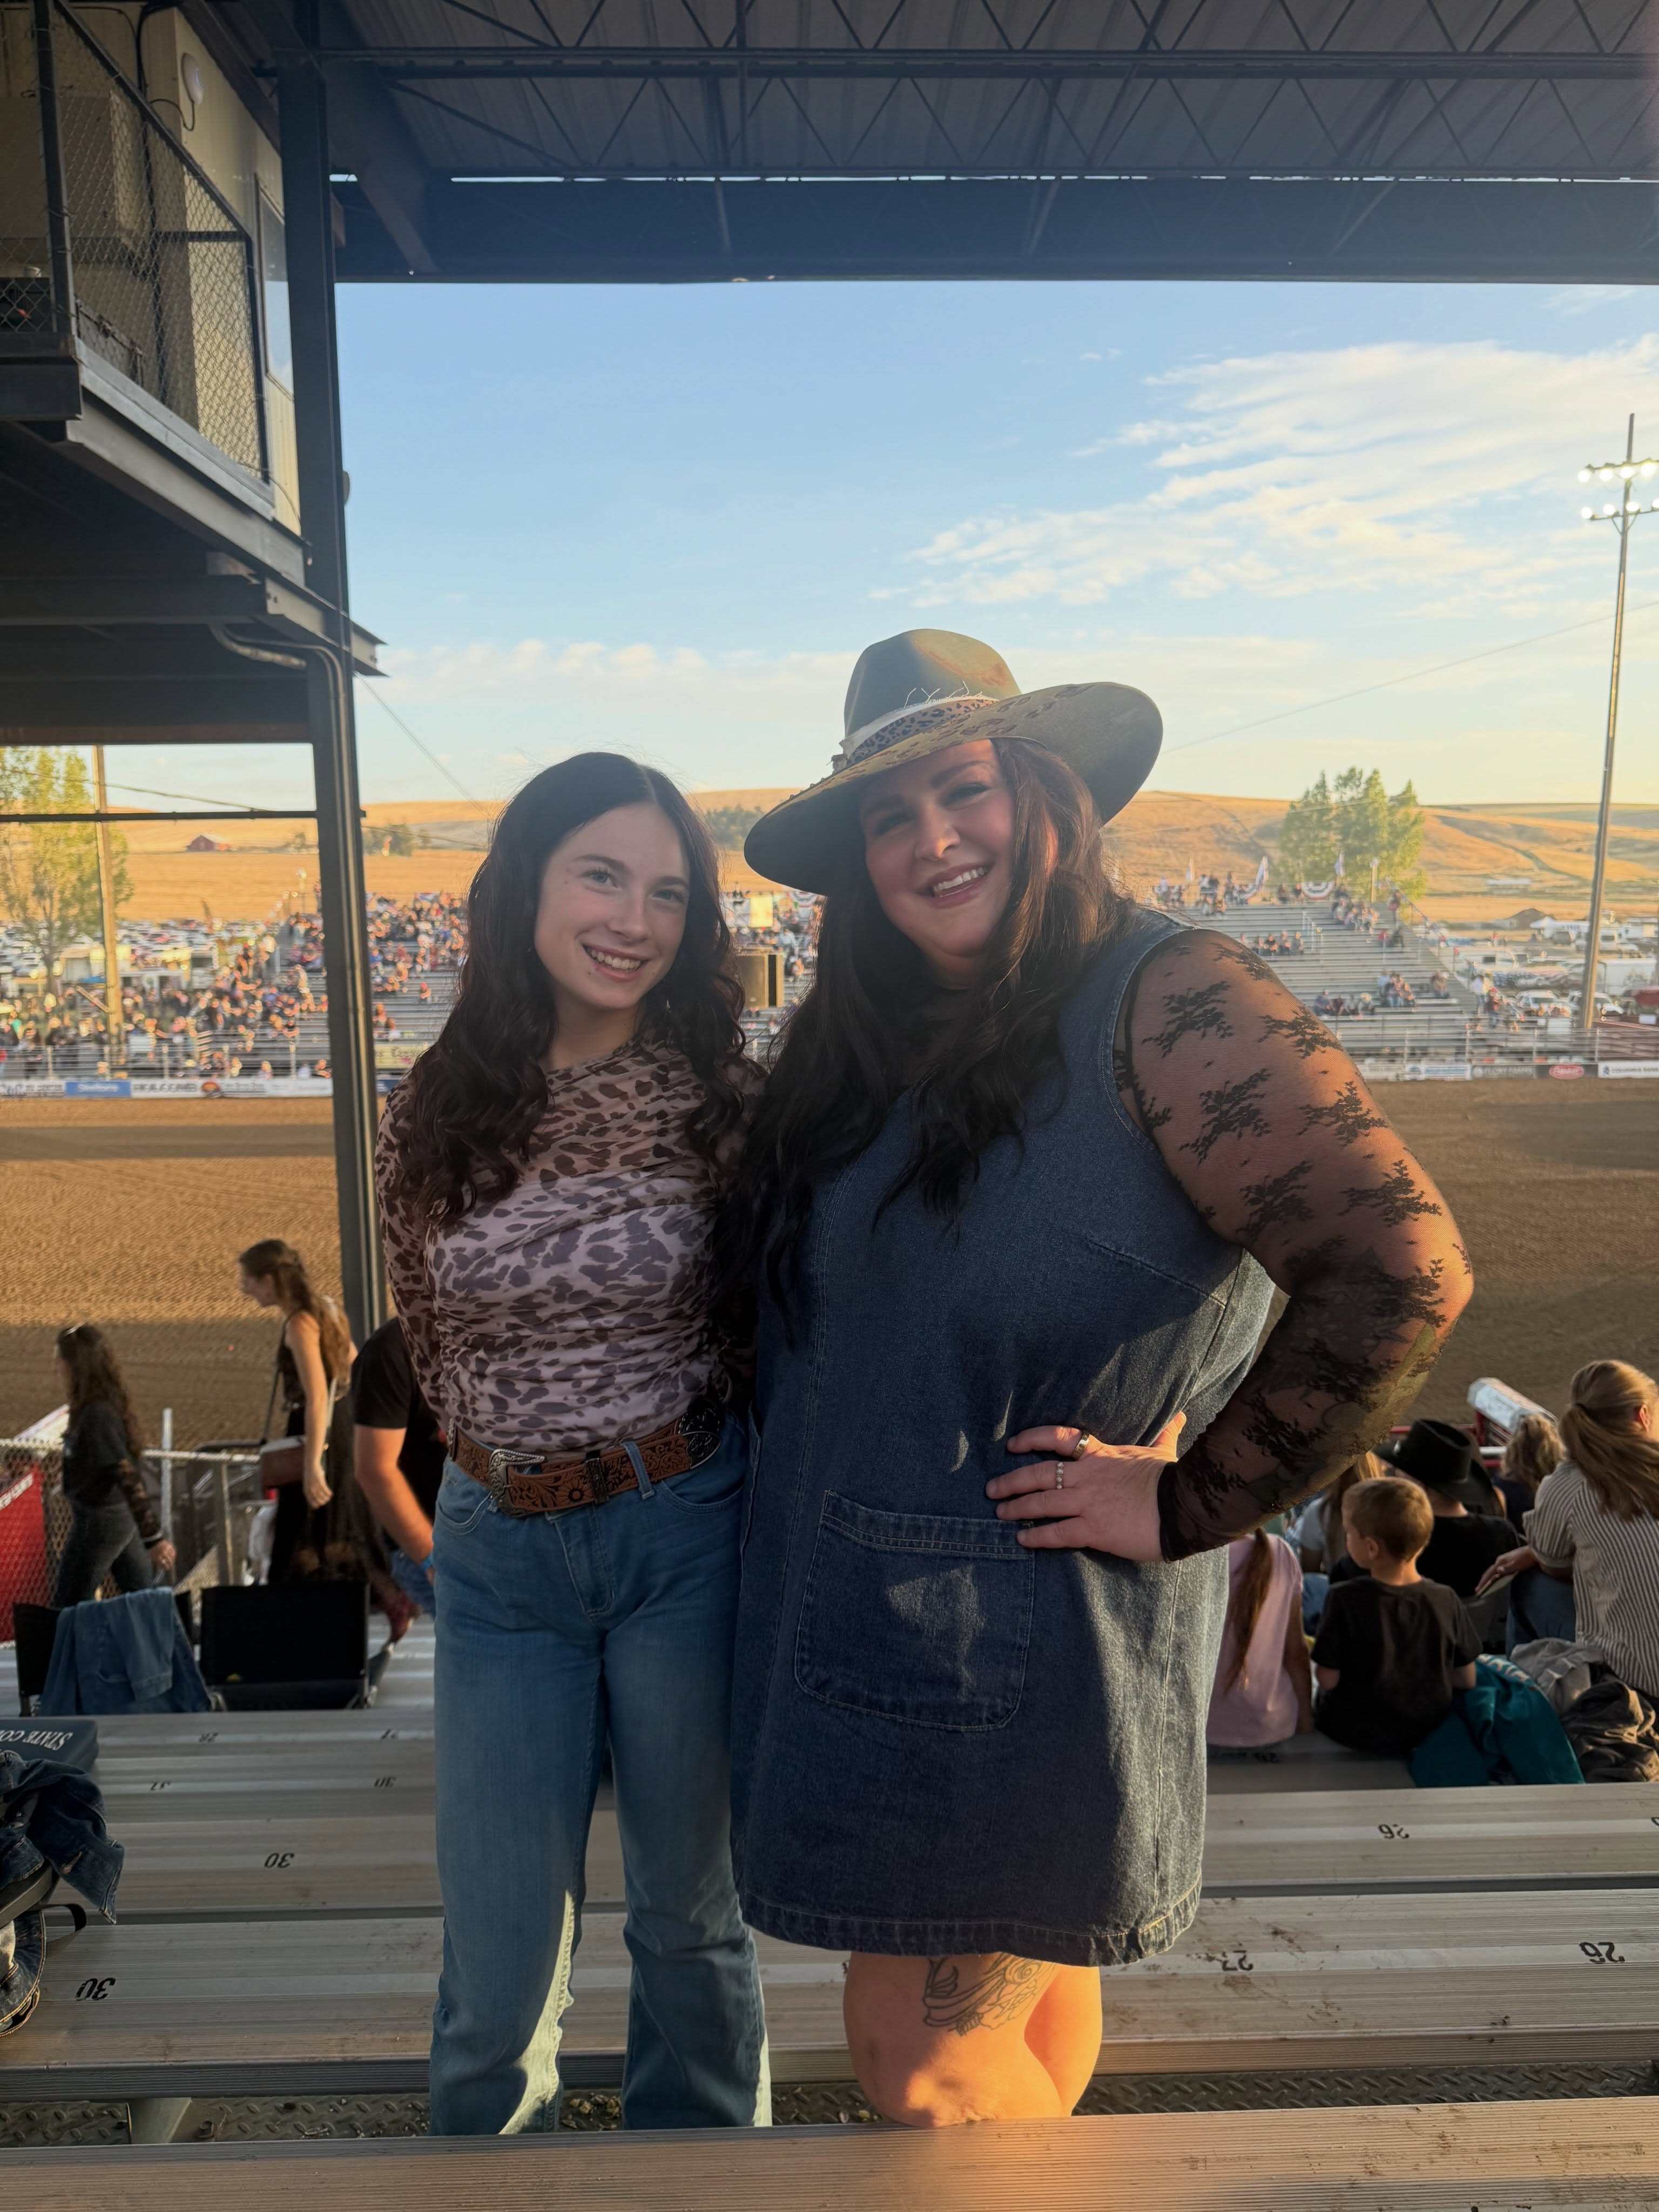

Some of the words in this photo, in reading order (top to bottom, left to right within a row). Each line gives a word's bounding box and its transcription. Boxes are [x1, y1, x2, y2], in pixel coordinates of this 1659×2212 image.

[0, 1730, 25, 1742] CO
[23, 1730, 73, 1751] STATE
[1378, 1824, 1410, 1839] 26
[264, 1852, 295, 1868] 30
[1222, 1950, 1253, 1972] 27
[1579, 1941, 1625, 1964] 26
[75, 1977, 116, 2001] 30
